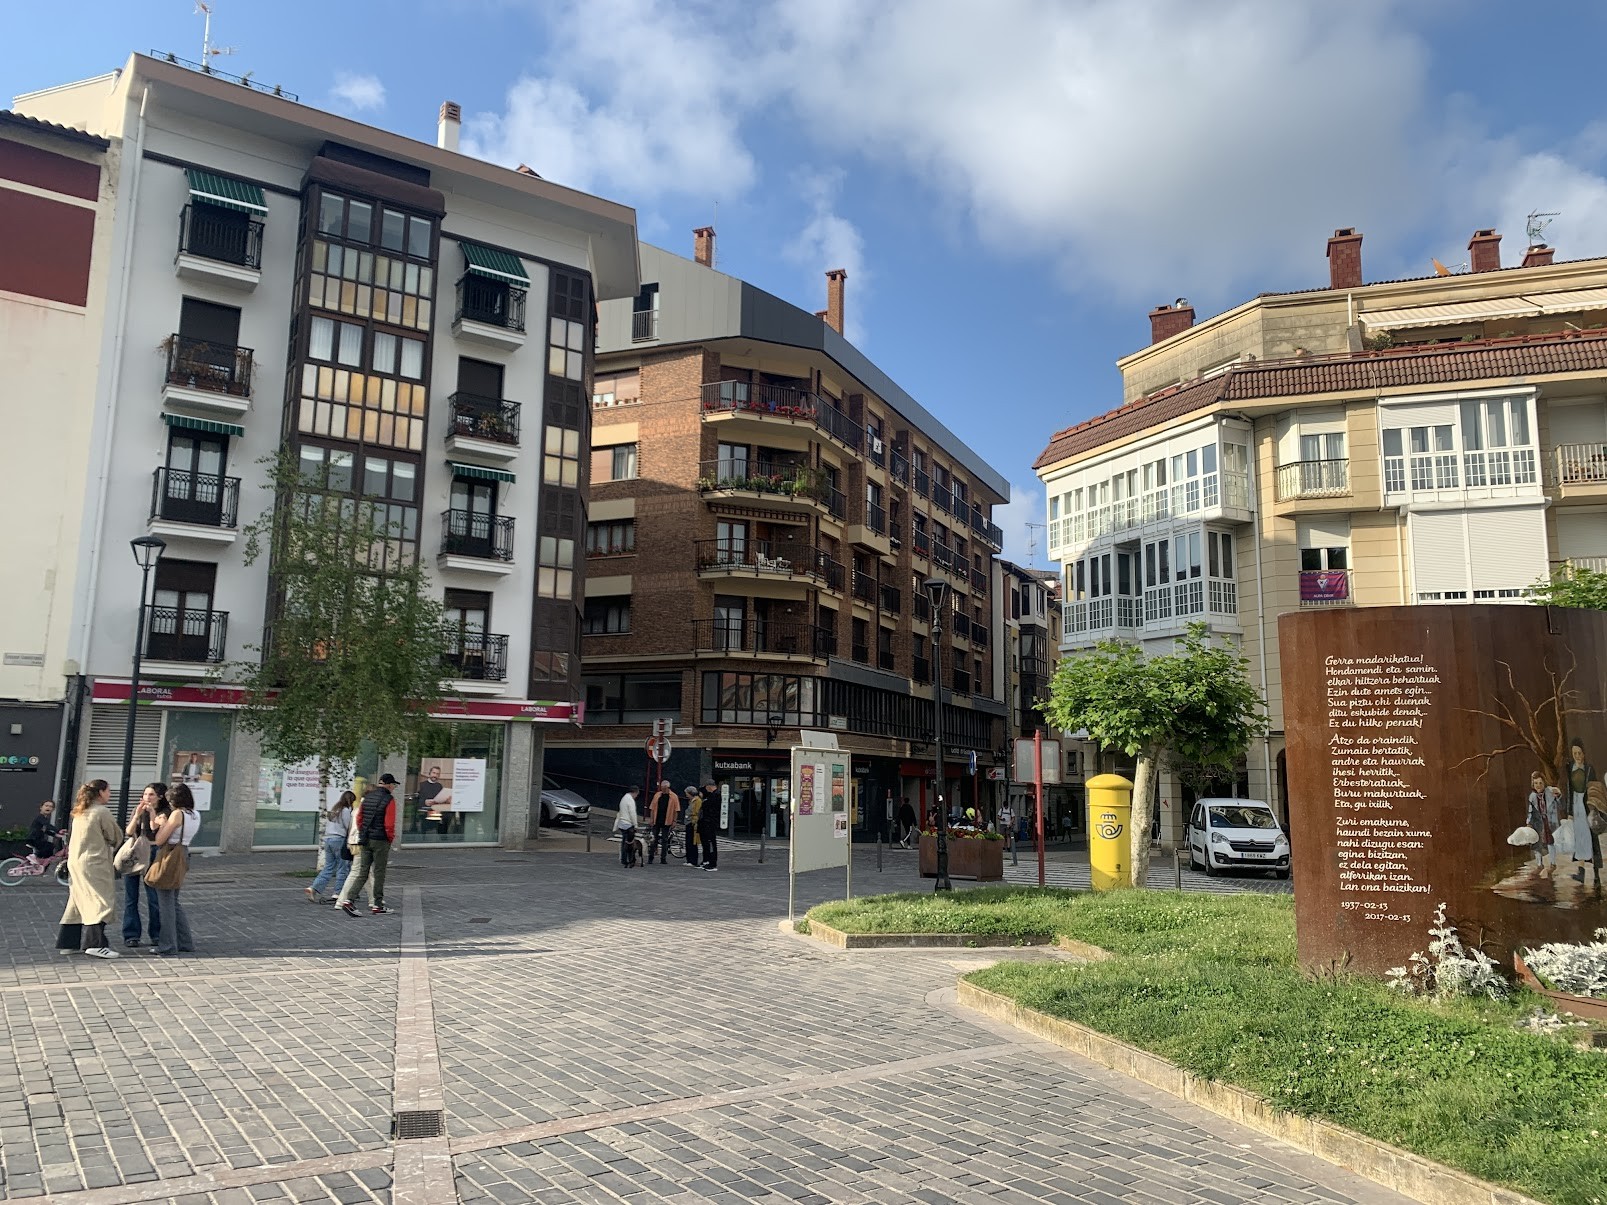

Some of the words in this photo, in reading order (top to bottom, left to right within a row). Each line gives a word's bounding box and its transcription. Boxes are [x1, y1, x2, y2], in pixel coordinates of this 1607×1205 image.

[1325, 655, 1354, 665] Gerra
[1356, 654, 1424, 664] madarikatua!
[1325, 666, 1384, 675] Hondamendi
[1327, 678, 1353, 686] elkar
[1354, 677, 1391, 685] hiltzera
[1392, 675, 1441, 684] behartuak
[1327, 687, 1349, 696] Ezin
[1350, 687, 1372, 696] dute
[1327, 698, 1348, 707] Sua
[1349, 698, 1373, 709] piztu
[1375, 697, 1391, 706] ohi
[1393, 697, 1432, 705] duenak
[1328, 708, 1348, 717] ditu
[1350, 708, 1390, 716] eskubide
[1329, 719, 1340, 728] Ez
[1342, 719, 1357, 727] du
[1359, 719, 1383, 727] hilko
[1385, 718, 1423, 729] penak!
[1328, 734, 1355, 745] Atzo
[1356, 736, 1371, 744] da
[1331, 746, 1370, 755] Zumaia
[714, 761, 752, 769] kutxabank
[1331, 757, 1360, 766] andre
[1362, 757, 1379, 765] eta
[1381, 757, 1426, 766] haurrak
[1332, 768, 1356, 776] ihesi
[1333, 788, 1361, 797] Buru
[1334, 800, 1353, 808] Eta,
[1354, 801, 1367, 811] gu
[1336, 817, 1359, 826] Zuri
[1359, 818, 1410, 827] emakume,
[1336, 828, 1371, 837] haundi
[1373, 828, 1404, 837] bezain
[1337, 839, 1360, 848] nahi
[1361, 839, 1395, 850] dizugu
[1337, 850, 1366, 861] egina
[1367, 850, 1408, 860] bizitzan,
[1350, 861, 1373, 869] dela
[1373, 861, 1409, 871] egitan,
[1339, 871, 1388, 881] alferrikan
[1389, 872, 1414, 881] izan.
[1340, 882, 1359, 891] Lan
[1382, 882, 1431, 894] baizikan!
[1340, 901, 1388, 910] 1937-02-13
[1365, 913, 1411, 922] 2017-02-13
